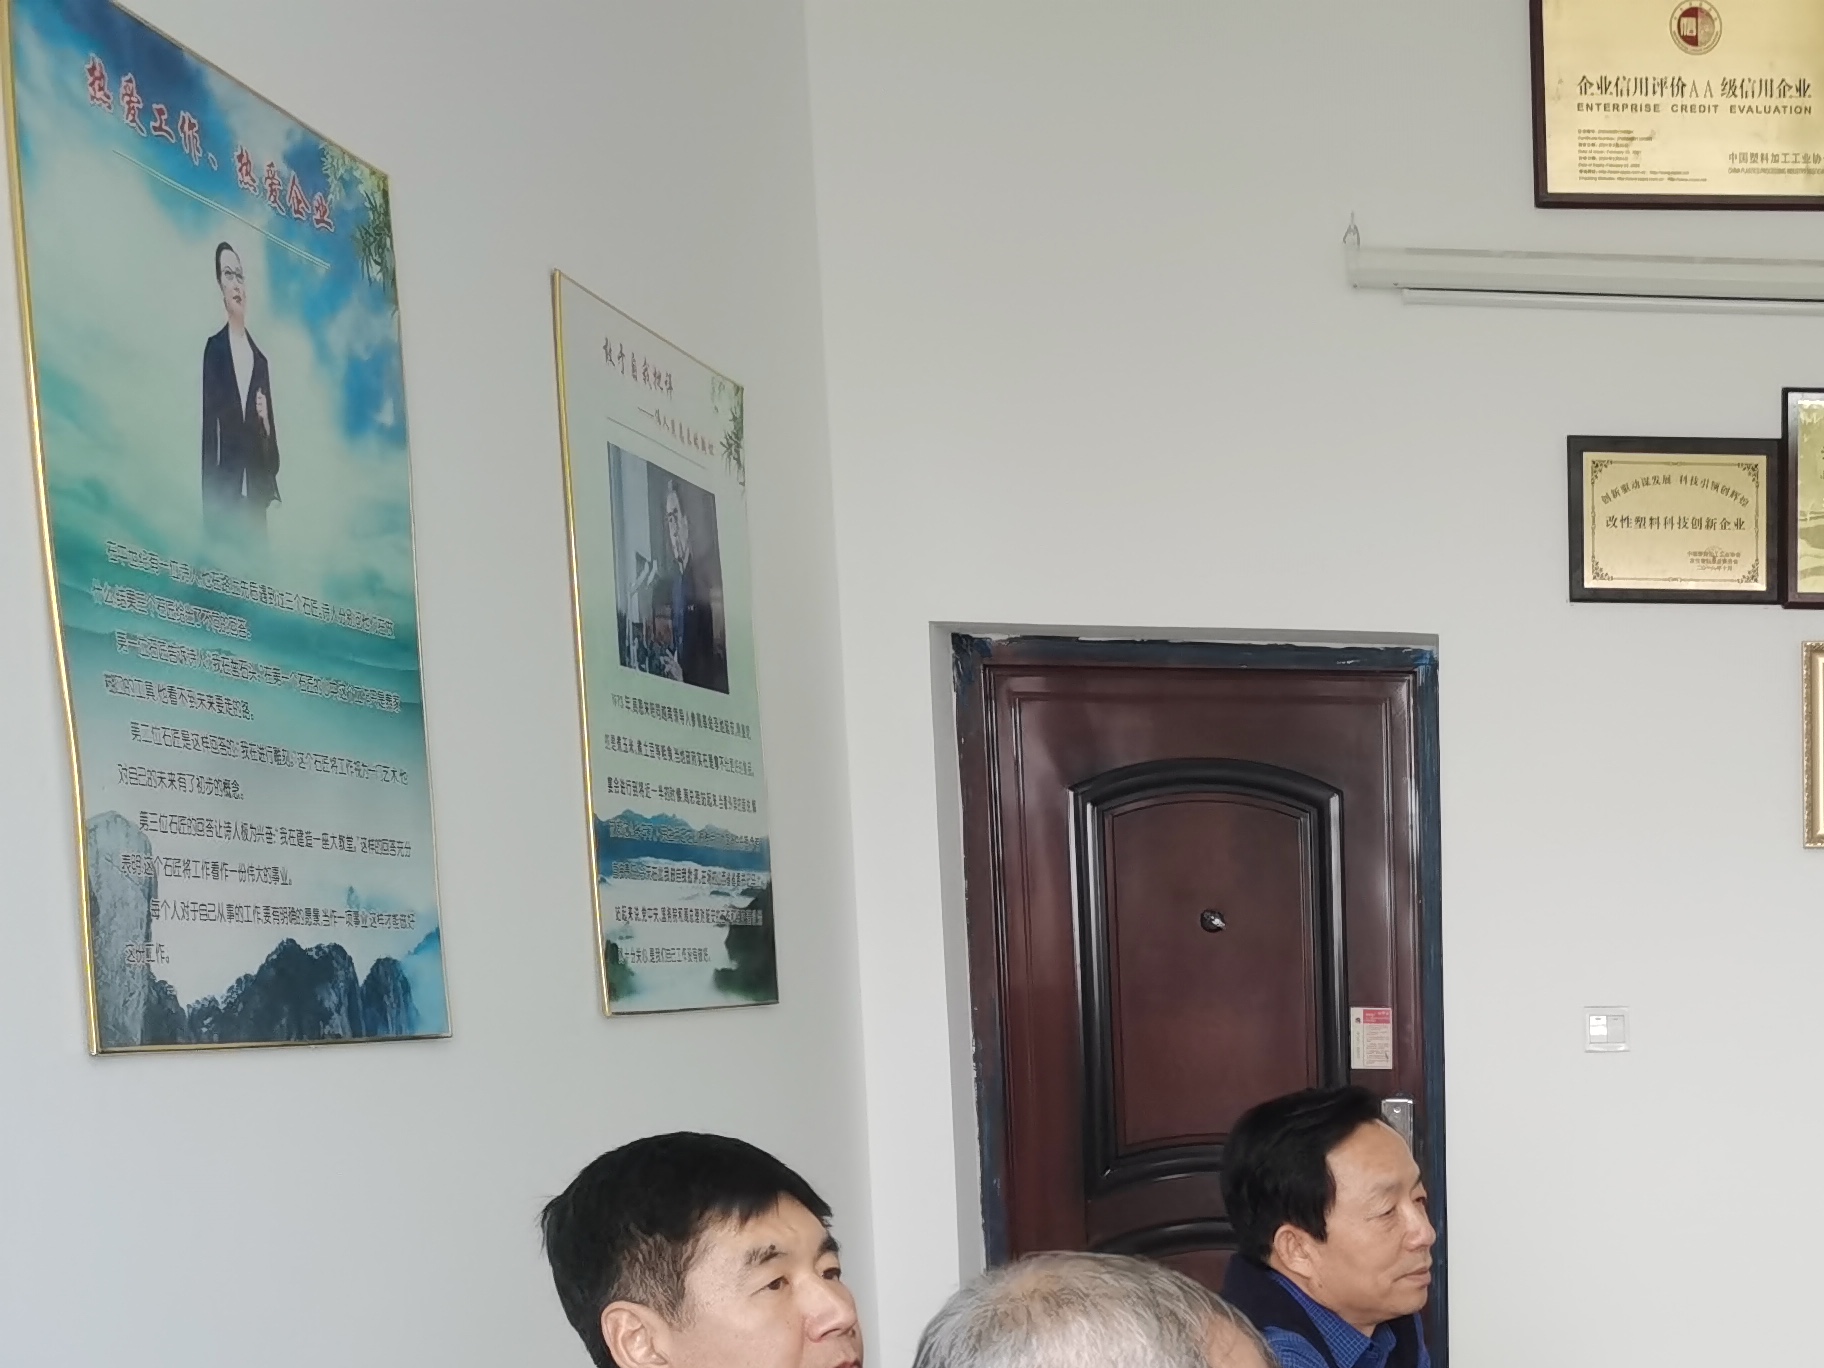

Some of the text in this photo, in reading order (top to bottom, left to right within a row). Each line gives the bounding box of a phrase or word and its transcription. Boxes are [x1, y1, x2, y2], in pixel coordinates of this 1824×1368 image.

[1577, 102, 1812, 115] ENTERPRISE CREDIT EVALUATION
[84, 53, 335, 231] 热爱工作、热爱企业
[1605, 514, 1746, 531] 改性塑料科技创新企业
